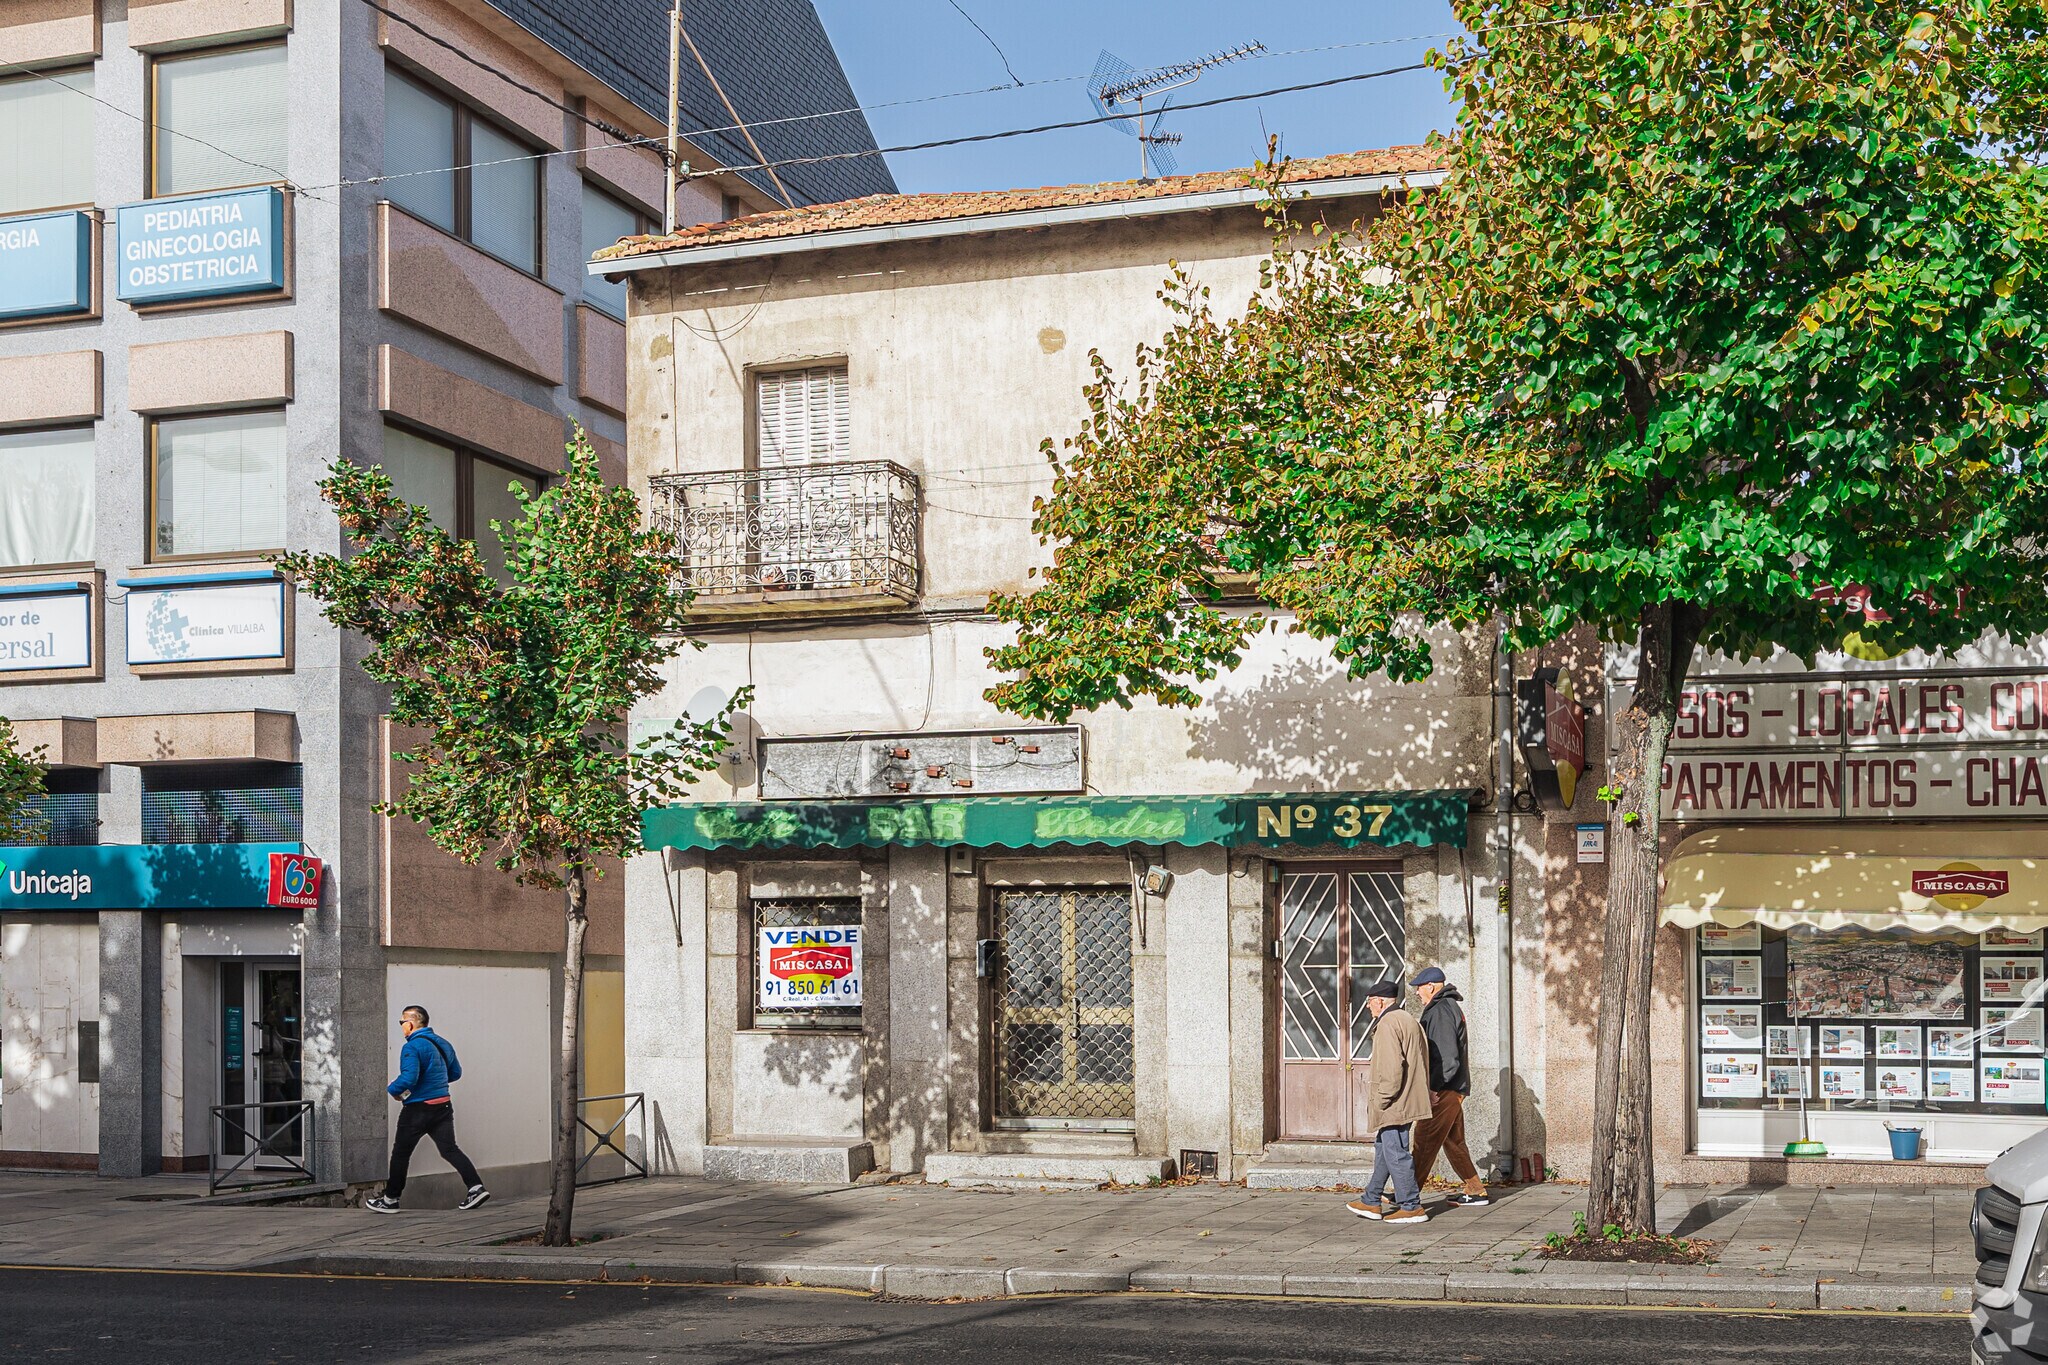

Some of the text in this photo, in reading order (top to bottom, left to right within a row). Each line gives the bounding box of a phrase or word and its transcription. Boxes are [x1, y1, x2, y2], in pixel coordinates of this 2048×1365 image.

[144, 203, 243, 232] PEDIATRIA
[126, 227, 262, 261] GINECOLOGIA
[129, 255, 259, 286] OBSTETRICIA
[21, 611, 40, 625] de
[188, 623, 265, 637] Clínica VILLALBA
[1798, 684, 1965, 738] LOCALES
[1550, 720, 1581, 757] MISCASA
[868, 804, 965, 840] BAR
[1333, 805, 1393, 838] 37
[9, 869, 93, 901] Unicaja
[1923, 881, 1998, 891] MISCASA
[282, 895, 318, 906] EURO 6000
[765, 929, 858, 945] VENDE
[779, 959, 843, 971] MISCASA
[765, 979, 858, 995] 91 850 61 61
